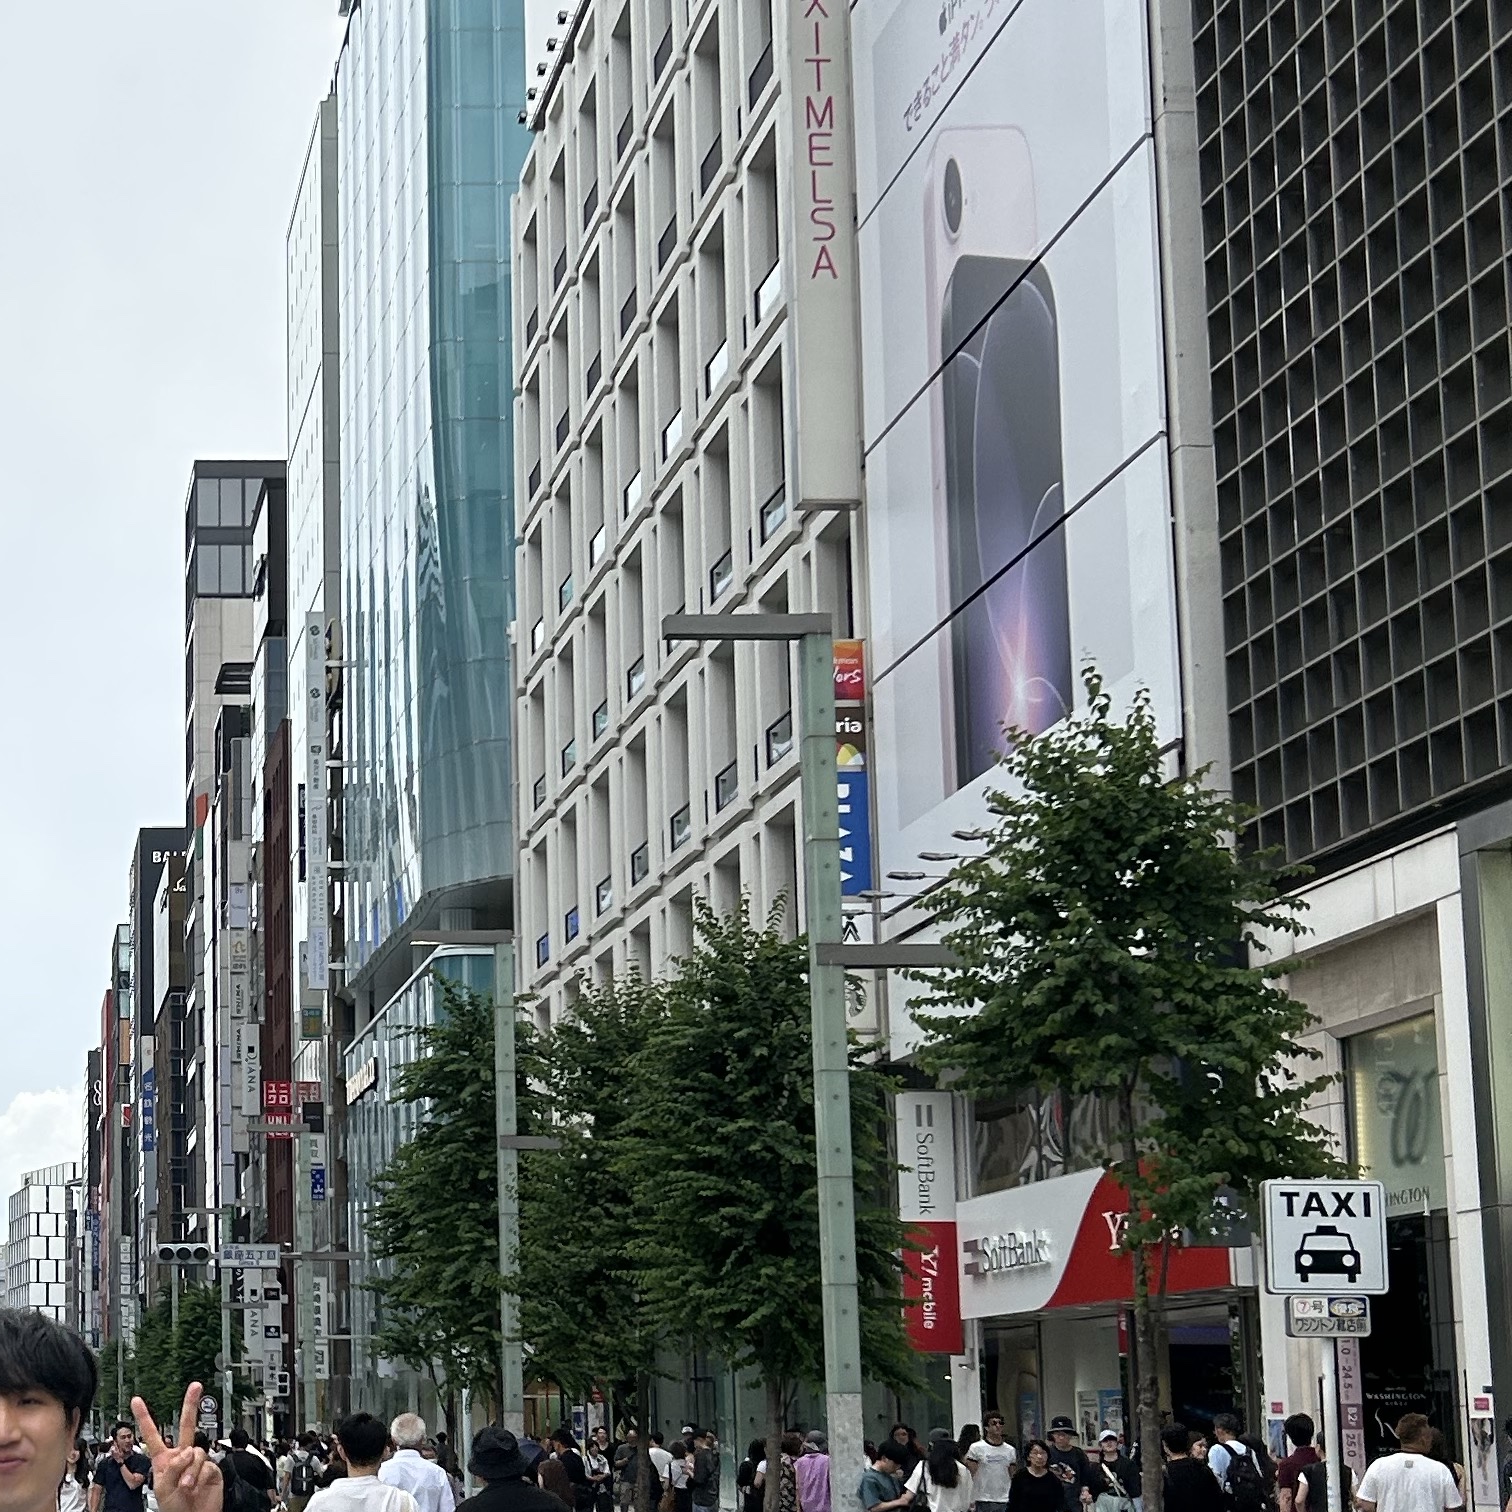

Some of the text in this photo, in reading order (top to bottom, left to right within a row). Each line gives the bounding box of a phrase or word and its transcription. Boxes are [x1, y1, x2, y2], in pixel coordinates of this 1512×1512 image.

[247, 1045, 257, 1093] DIANA
[915, 1132, 936, 1216] SoftBank
[1279, 1191, 1372, 1218] TAXI
[1385, 1186, 1431, 1208] INGTON
[981, 1229, 1050, 1273] SoftBank
[249, 1289, 260, 1337] DANA
[1365, 1392, 1426, 1401] WASHINGTON
